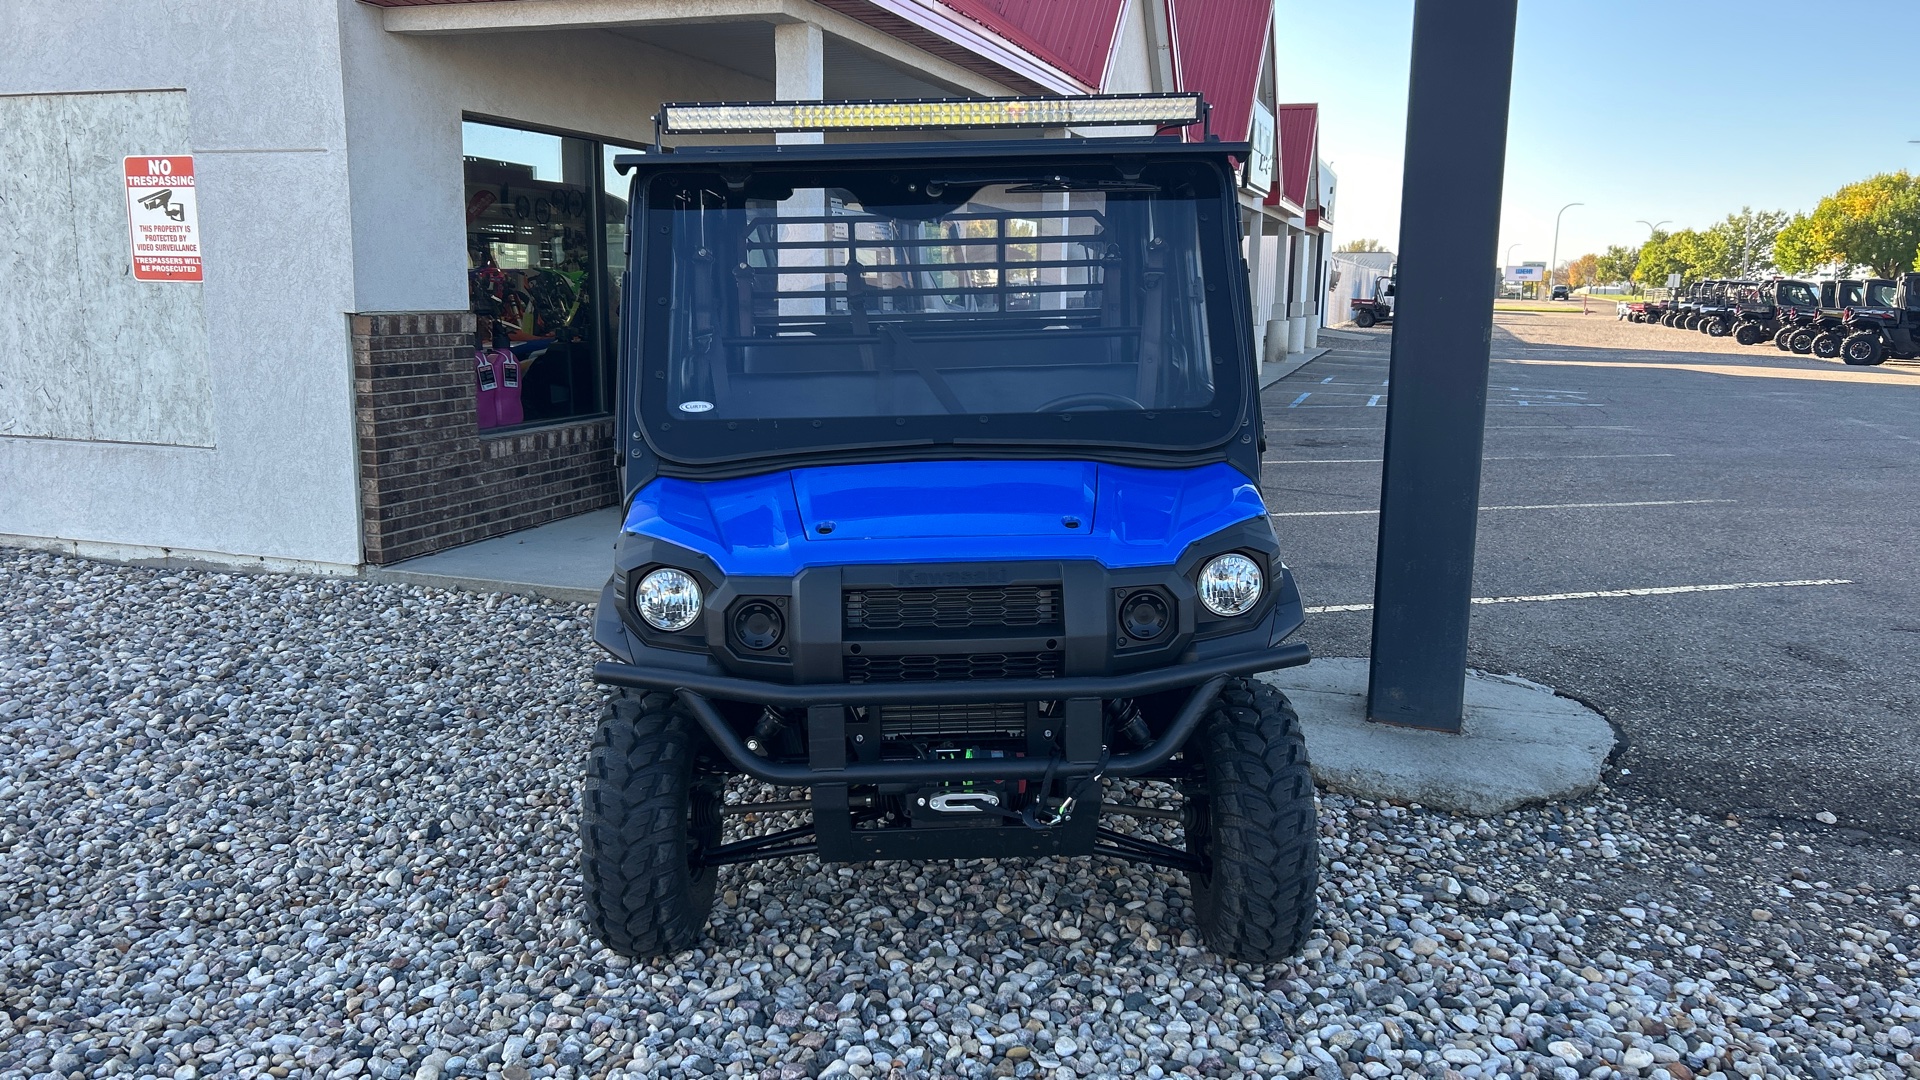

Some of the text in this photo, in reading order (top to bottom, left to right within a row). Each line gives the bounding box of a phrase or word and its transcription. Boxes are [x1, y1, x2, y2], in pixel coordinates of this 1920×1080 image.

[148, 159, 171, 175] NO
[128, 176, 194, 186] TRESPASSING
[139, 225, 191, 233] THIS PROPERTY IS
[145, 234, 178, 242] PROTECTED
[137, 243, 197, 252] VIDEO SURVEILLANCE
[135, 257, 201, 265] TRESPASSERS WILL
[141, 265, 197, 273] BE PROSECUTED
[900, 568, 1008, 585] Kawasaki
